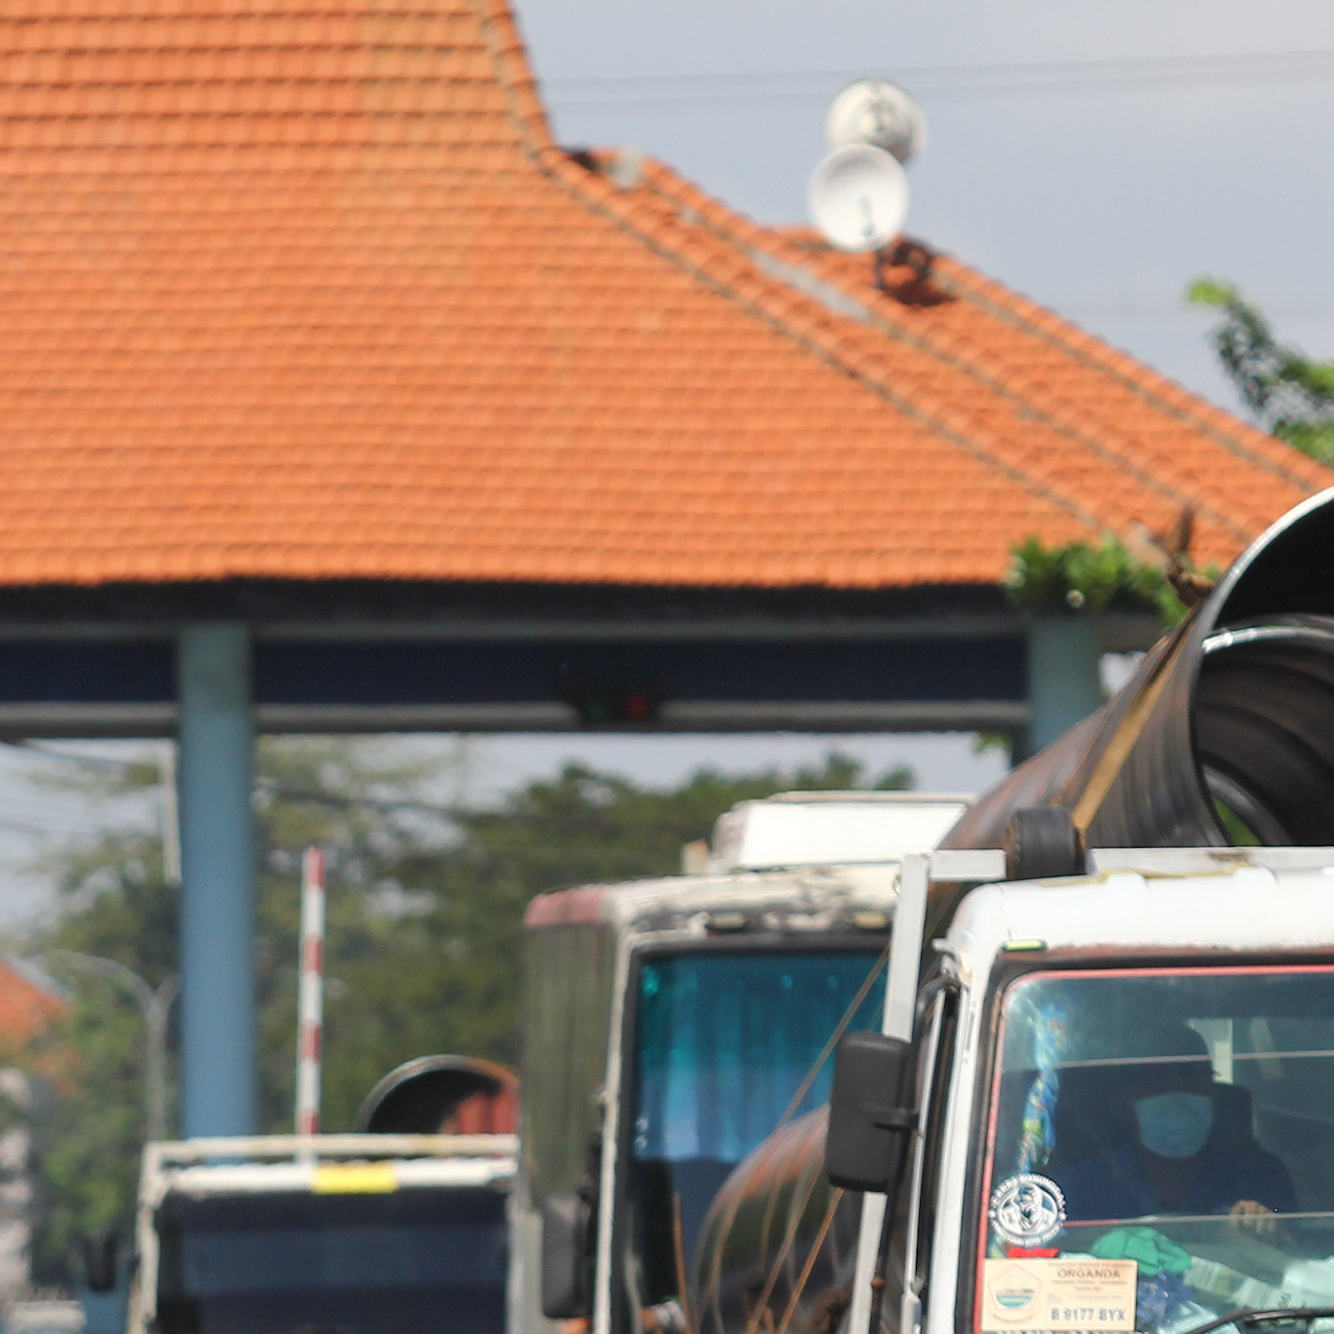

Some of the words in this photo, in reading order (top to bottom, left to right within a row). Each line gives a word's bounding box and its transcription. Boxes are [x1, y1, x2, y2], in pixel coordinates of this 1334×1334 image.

[1057, 1267, 1121, 1279] ORGANDA
[1051, 1308, 1060, 1321] B
[1064, 1308, 1095, 1321] 9177
[1099, 1307, 1126, 1321] BYX
